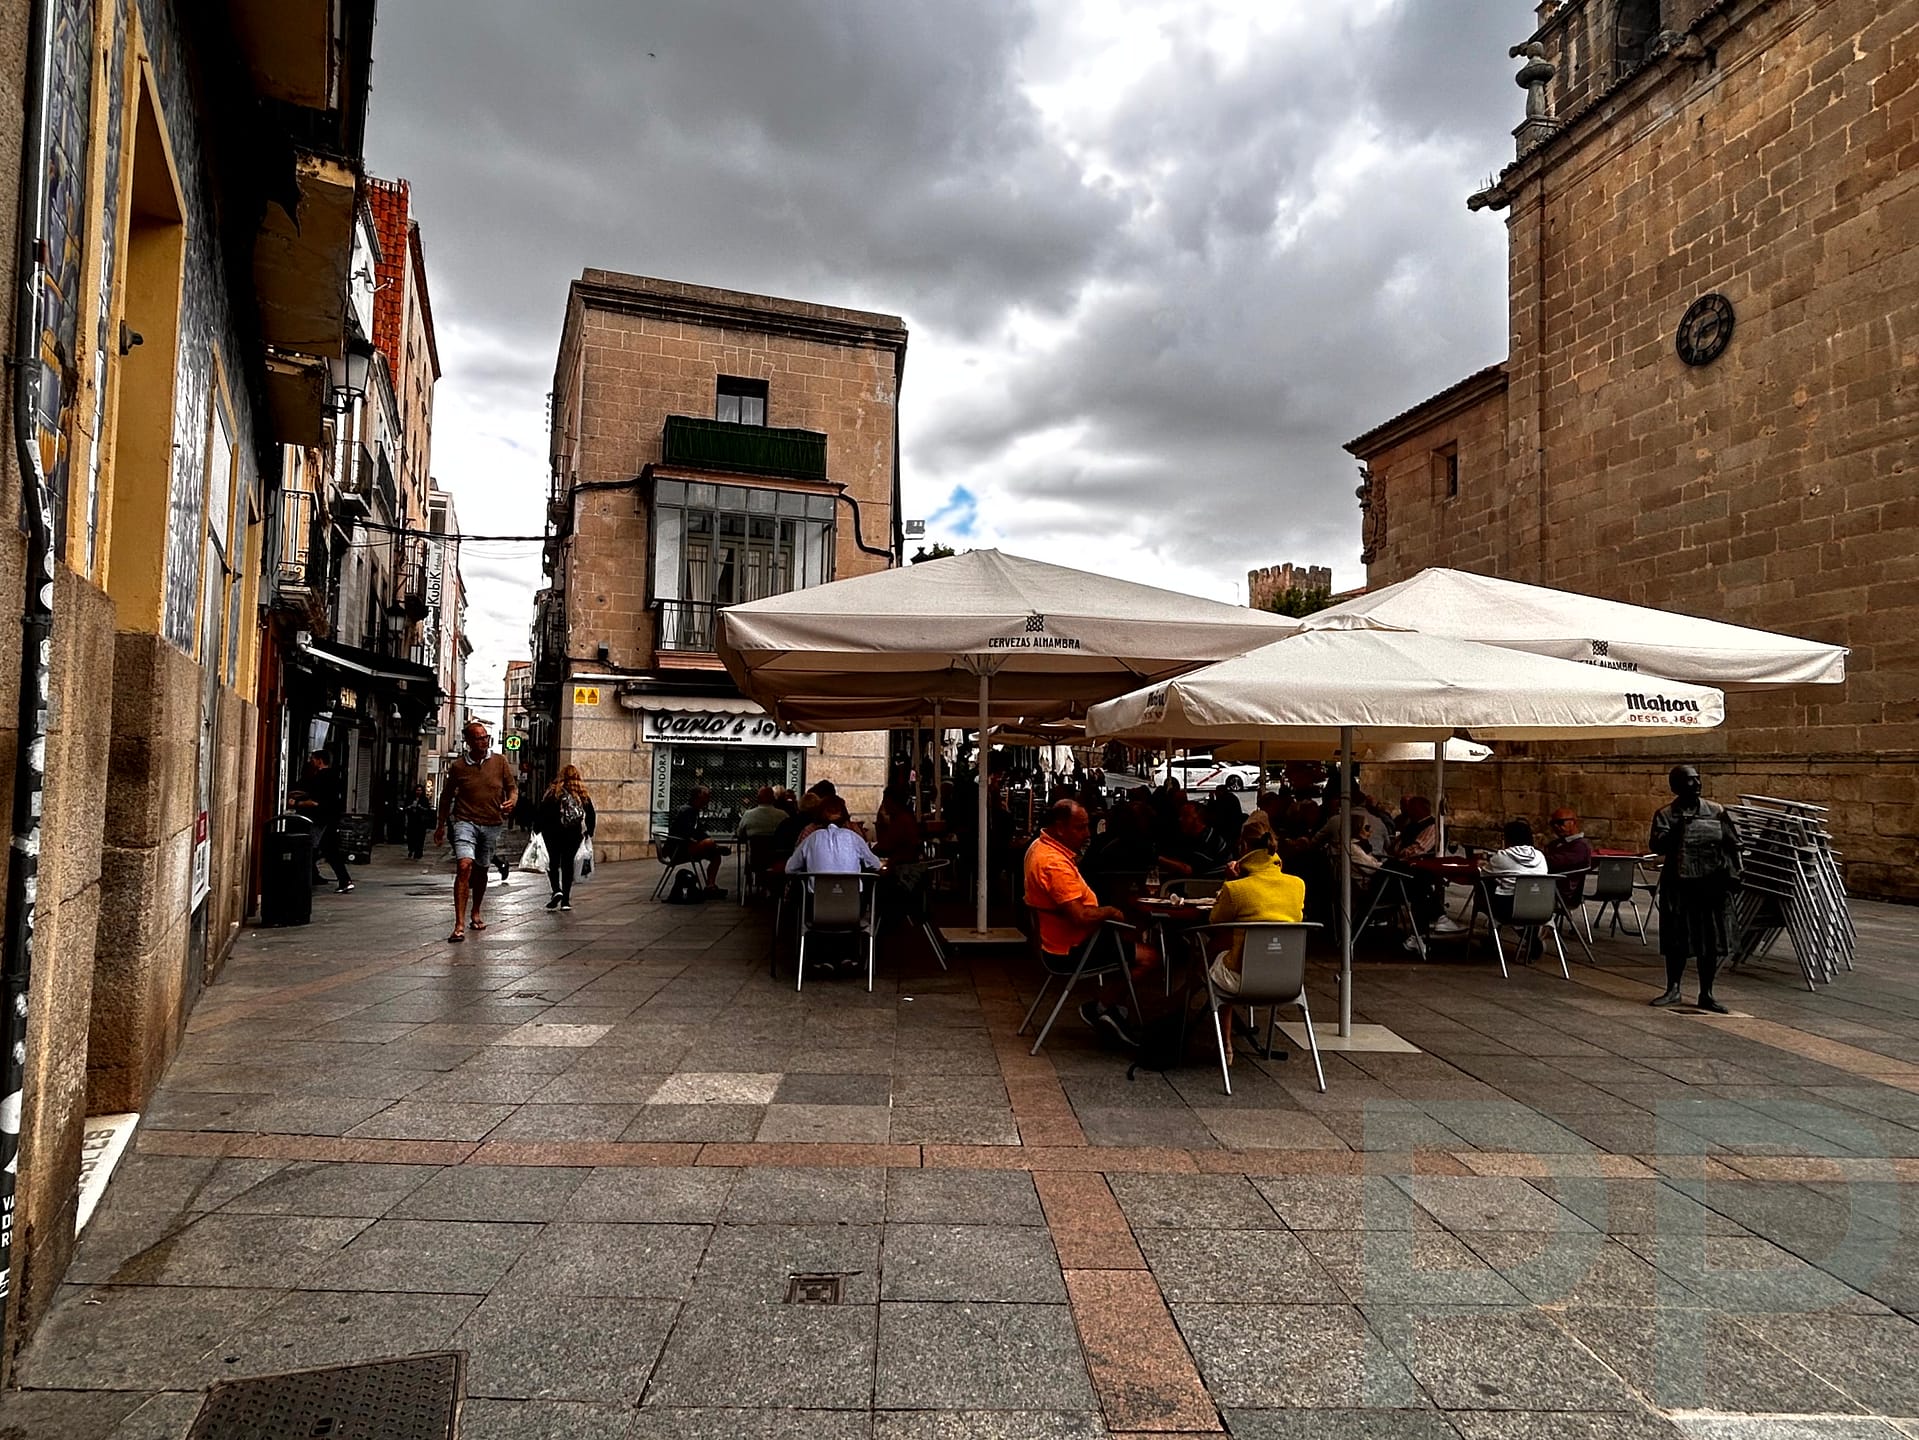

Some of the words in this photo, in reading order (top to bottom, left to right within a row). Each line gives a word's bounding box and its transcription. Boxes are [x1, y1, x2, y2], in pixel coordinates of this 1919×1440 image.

[988, 637, 1030, 648] CERVEZAS
[1033, 637, 1081, 649] ALHAMBRA
[1624, 692, 1700, 712] Mahou
[1629, 714, 1668, 723] DESDE
